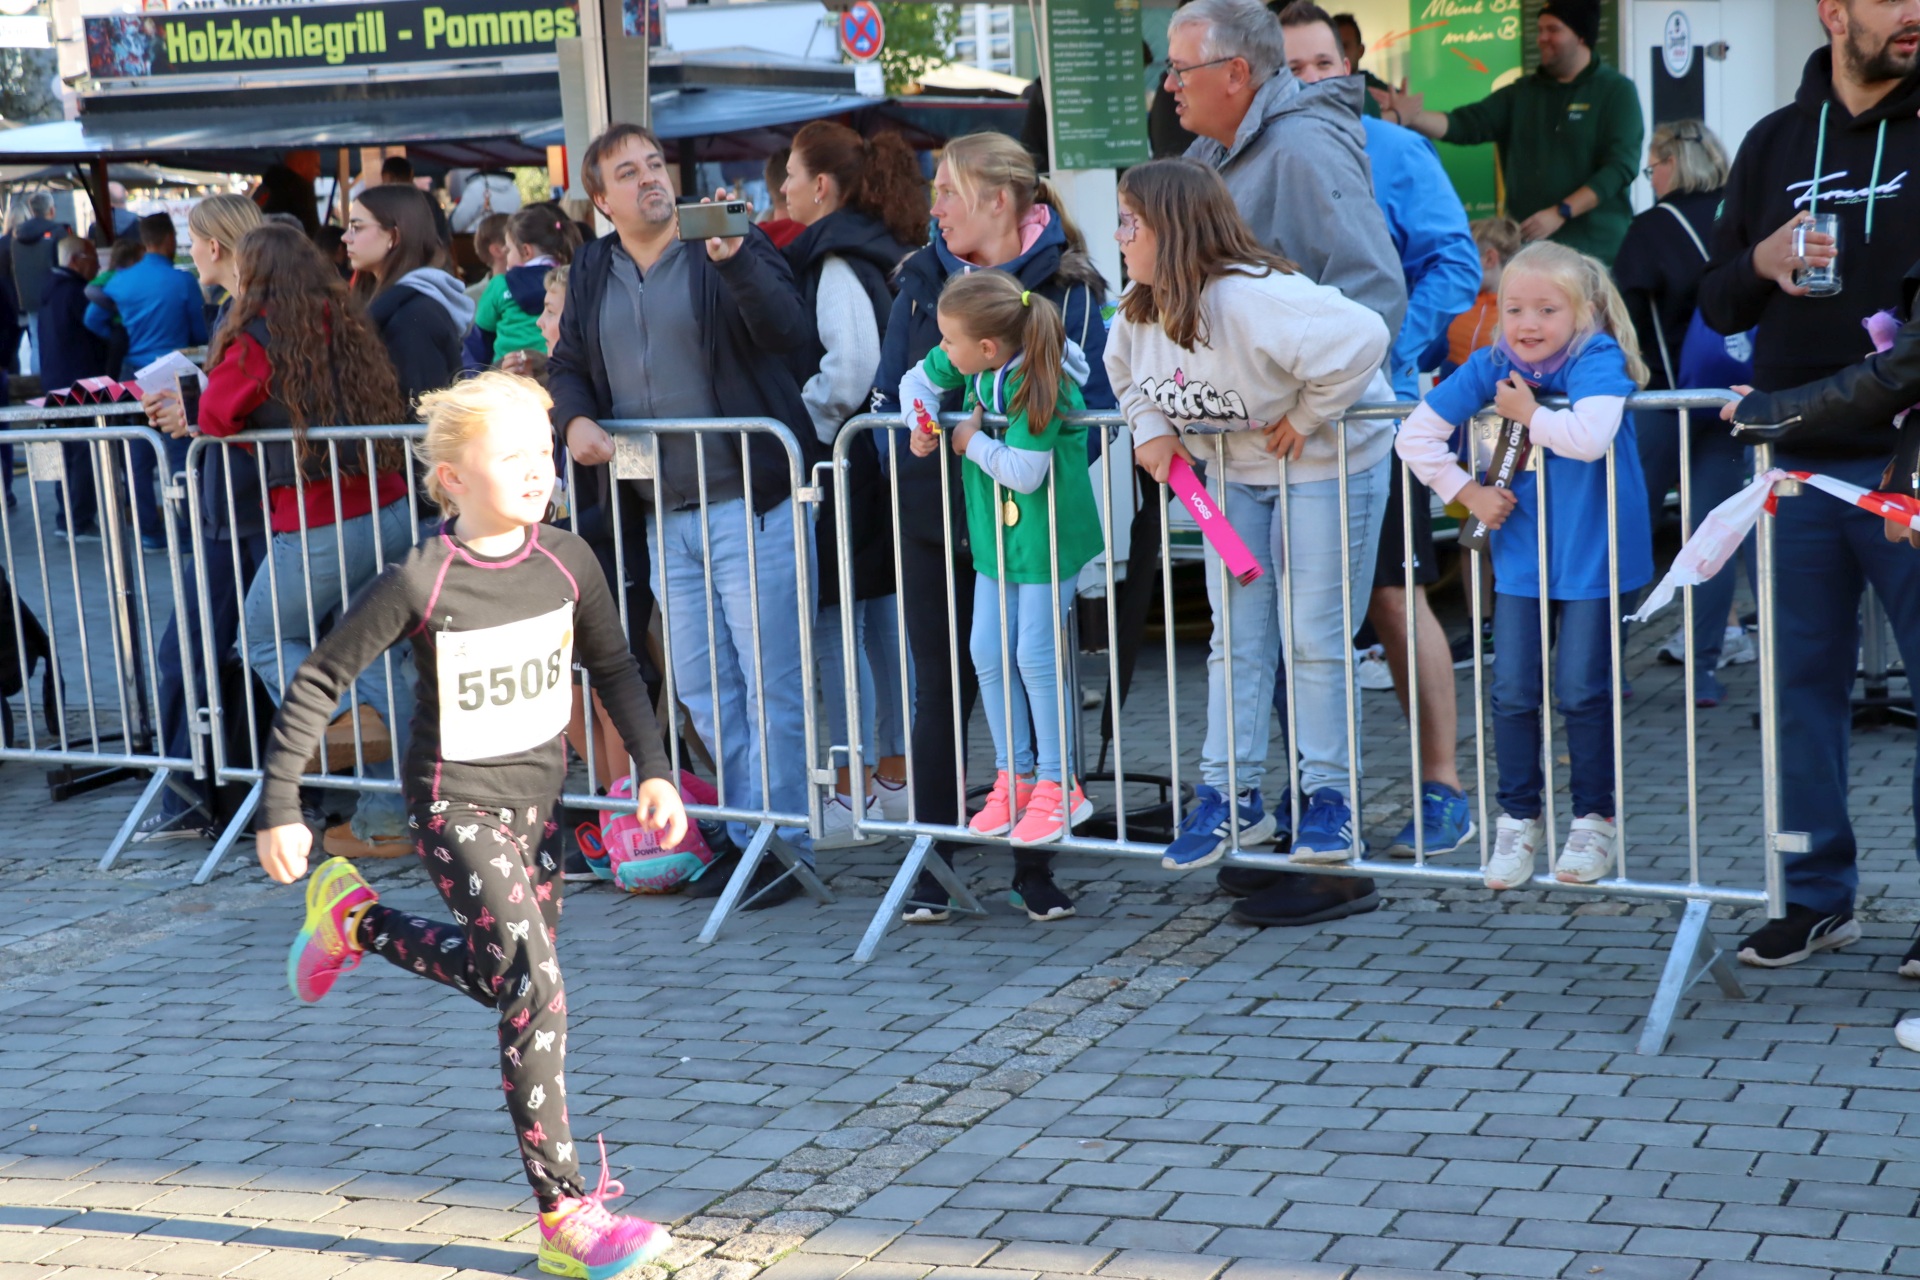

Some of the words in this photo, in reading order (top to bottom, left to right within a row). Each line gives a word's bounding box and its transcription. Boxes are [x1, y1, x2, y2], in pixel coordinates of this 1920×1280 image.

[165, 11, 387, 64] Holzkohlegrill
[423, 7, 577, 49] Pommes
[1498, 446, 1518, 480] NEUE
[1190, 492, 1213, 520] VOSS
[458, 648, 562, 711] 5508
